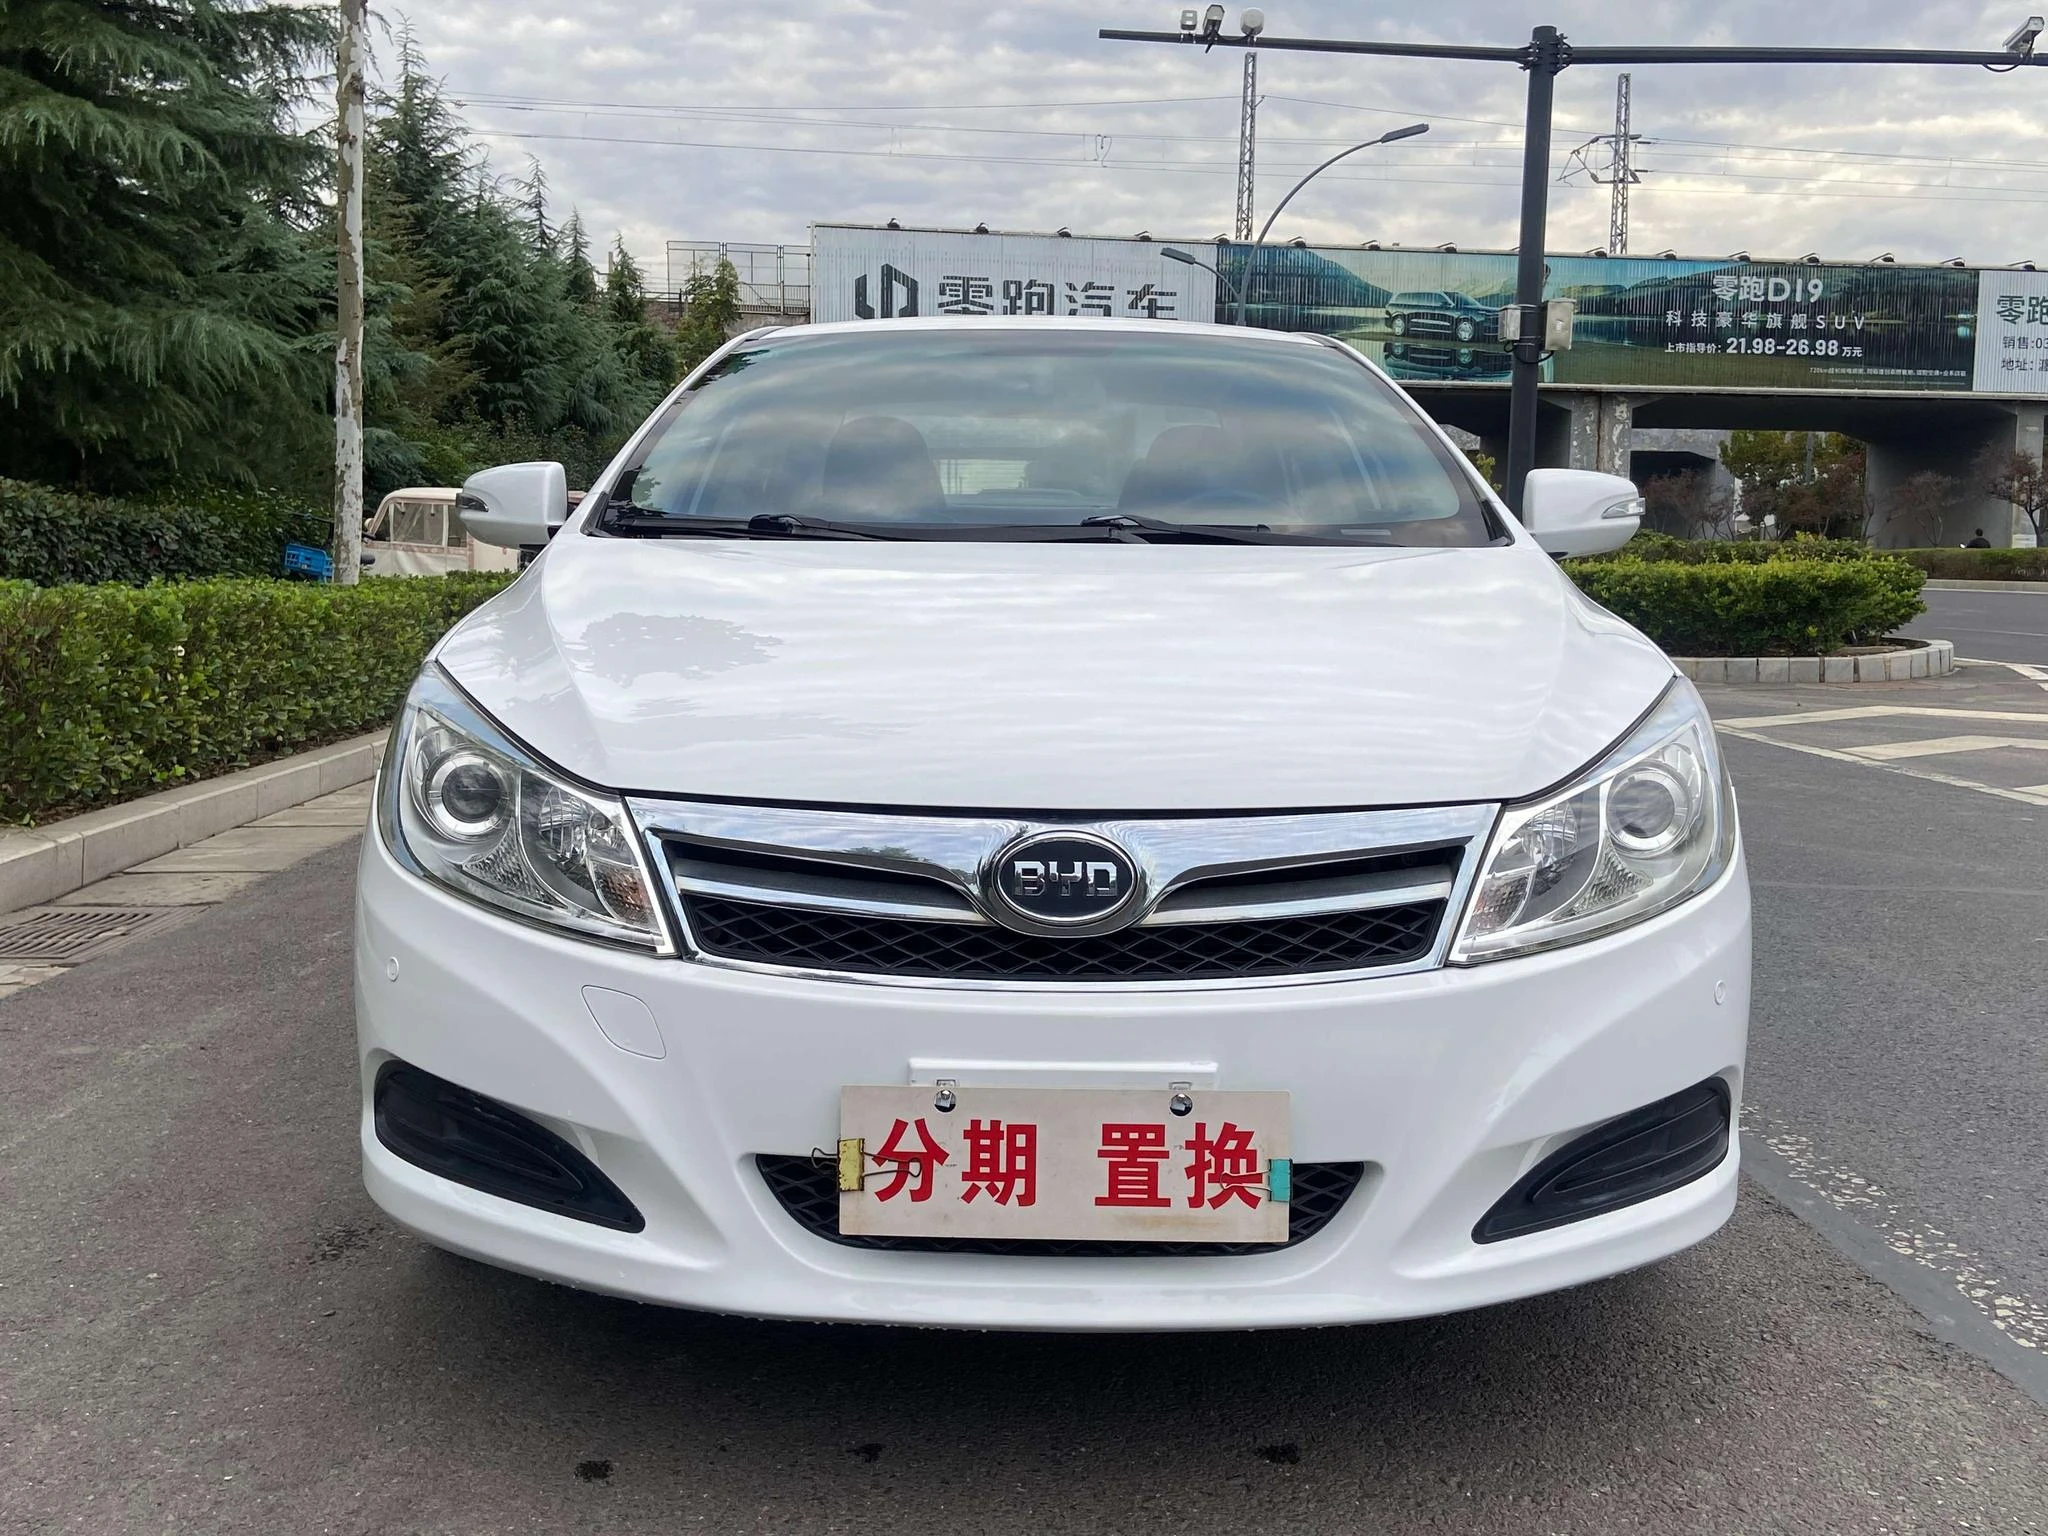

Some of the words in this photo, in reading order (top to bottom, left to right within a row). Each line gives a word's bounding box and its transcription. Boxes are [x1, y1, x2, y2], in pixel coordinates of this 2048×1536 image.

[938, 275, 1179, 320] 零跑汽车
[1996, 295, 2048, 325] 零跑
[1665, 309, 1865, 330] 科技豪华旗舰SUV
[1013, 860, 1118, 897] BYD
[872, 1118, 1037, 1207] 分期
[1094, 1121, 1263, 1210] 置换
